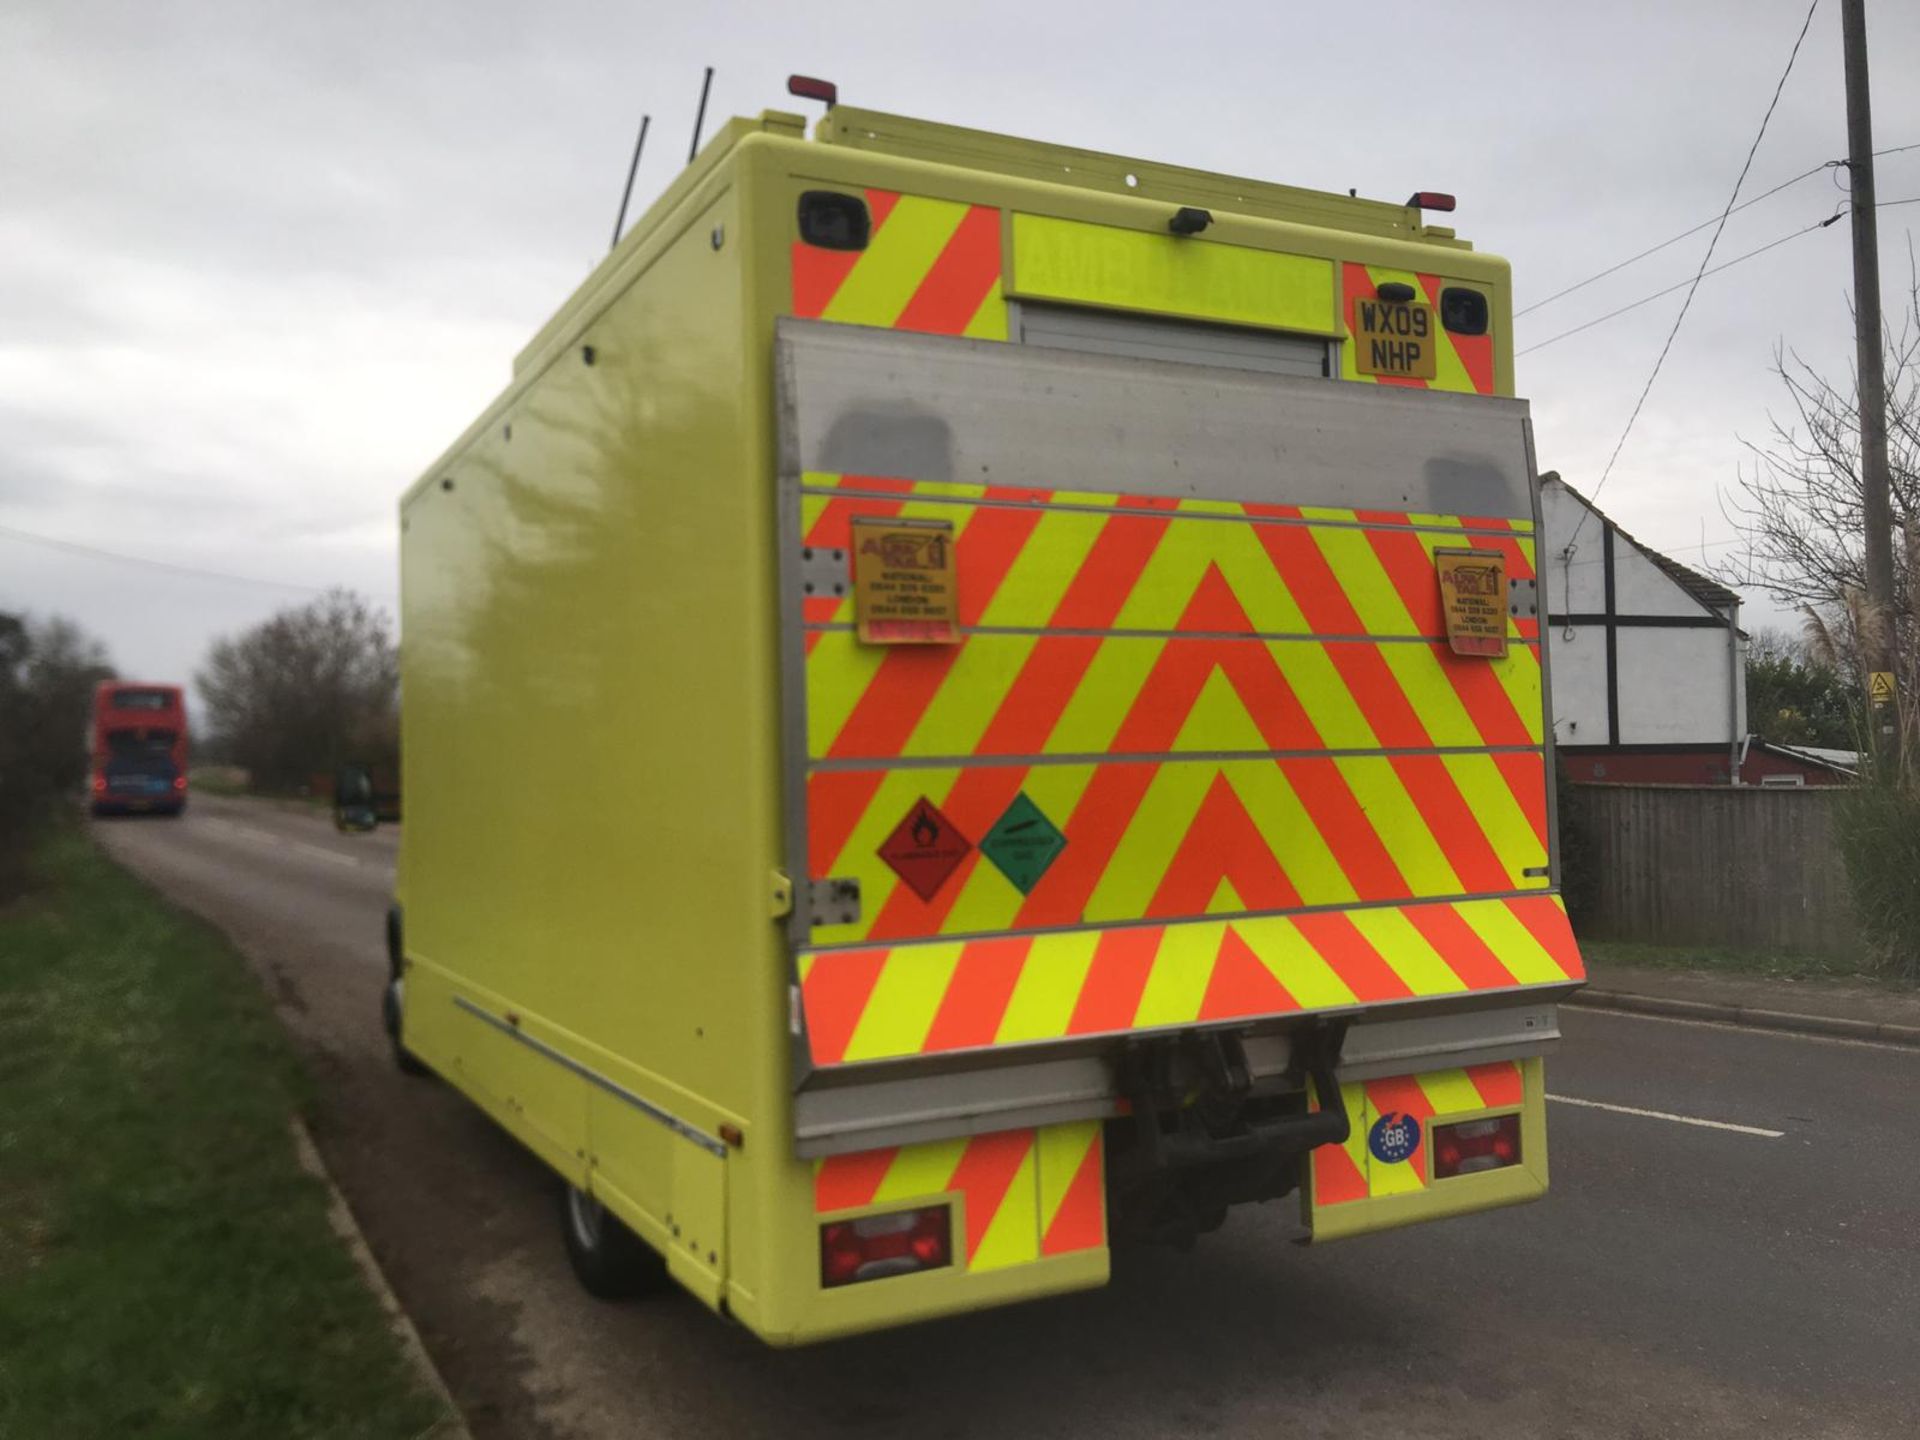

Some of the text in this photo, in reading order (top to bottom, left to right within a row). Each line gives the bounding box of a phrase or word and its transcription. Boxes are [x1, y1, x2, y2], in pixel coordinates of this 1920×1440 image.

[1361, 301, 1428, 338] WX09
[1371, 339, 1421, 372] NHP
[1385, 1128, 1405, 1147] GB
